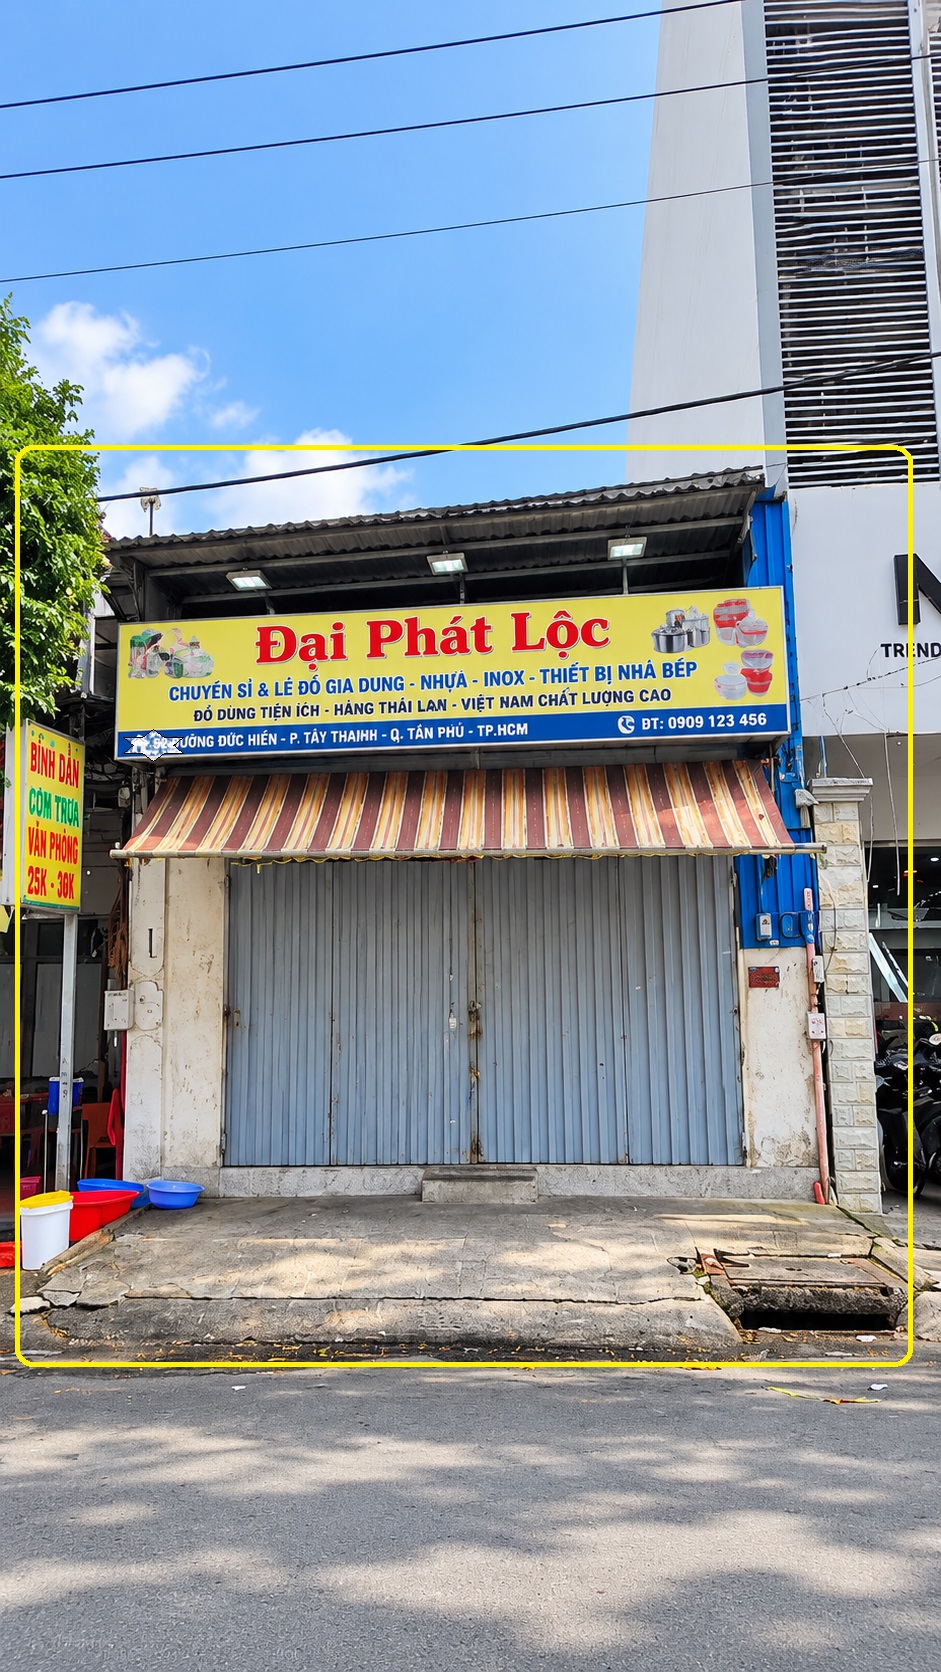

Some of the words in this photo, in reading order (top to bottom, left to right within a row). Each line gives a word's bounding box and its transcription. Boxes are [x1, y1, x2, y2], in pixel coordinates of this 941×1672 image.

[255, 622, 347, 671] Đại
[366, 615, 493, 659] Phát
[511, 610, 610, 660] Lộc
[259, 682, 269, 698] &
[325, 679, 354, 695] GIA
[484, 670, 525, 687] INOX
[539, 662, 589, 684] THIẾT
[595, 665, 612, 686] BỊ
[378, 697, 412, 715] THÁI
[499, 692, 534, 709] NAM
[639, 688, 671, 703] CAO
[289, 732, 300, 745] P.
[303, 729, 328, 745] TÂY
[477, 722, 528, 737] TP.HCM
[668, 714, 704, 729] 0909
[708, 713, 736, 728] 123
[739, 713, 767, 727] 456
[27, 865, 47, 897] 25K
